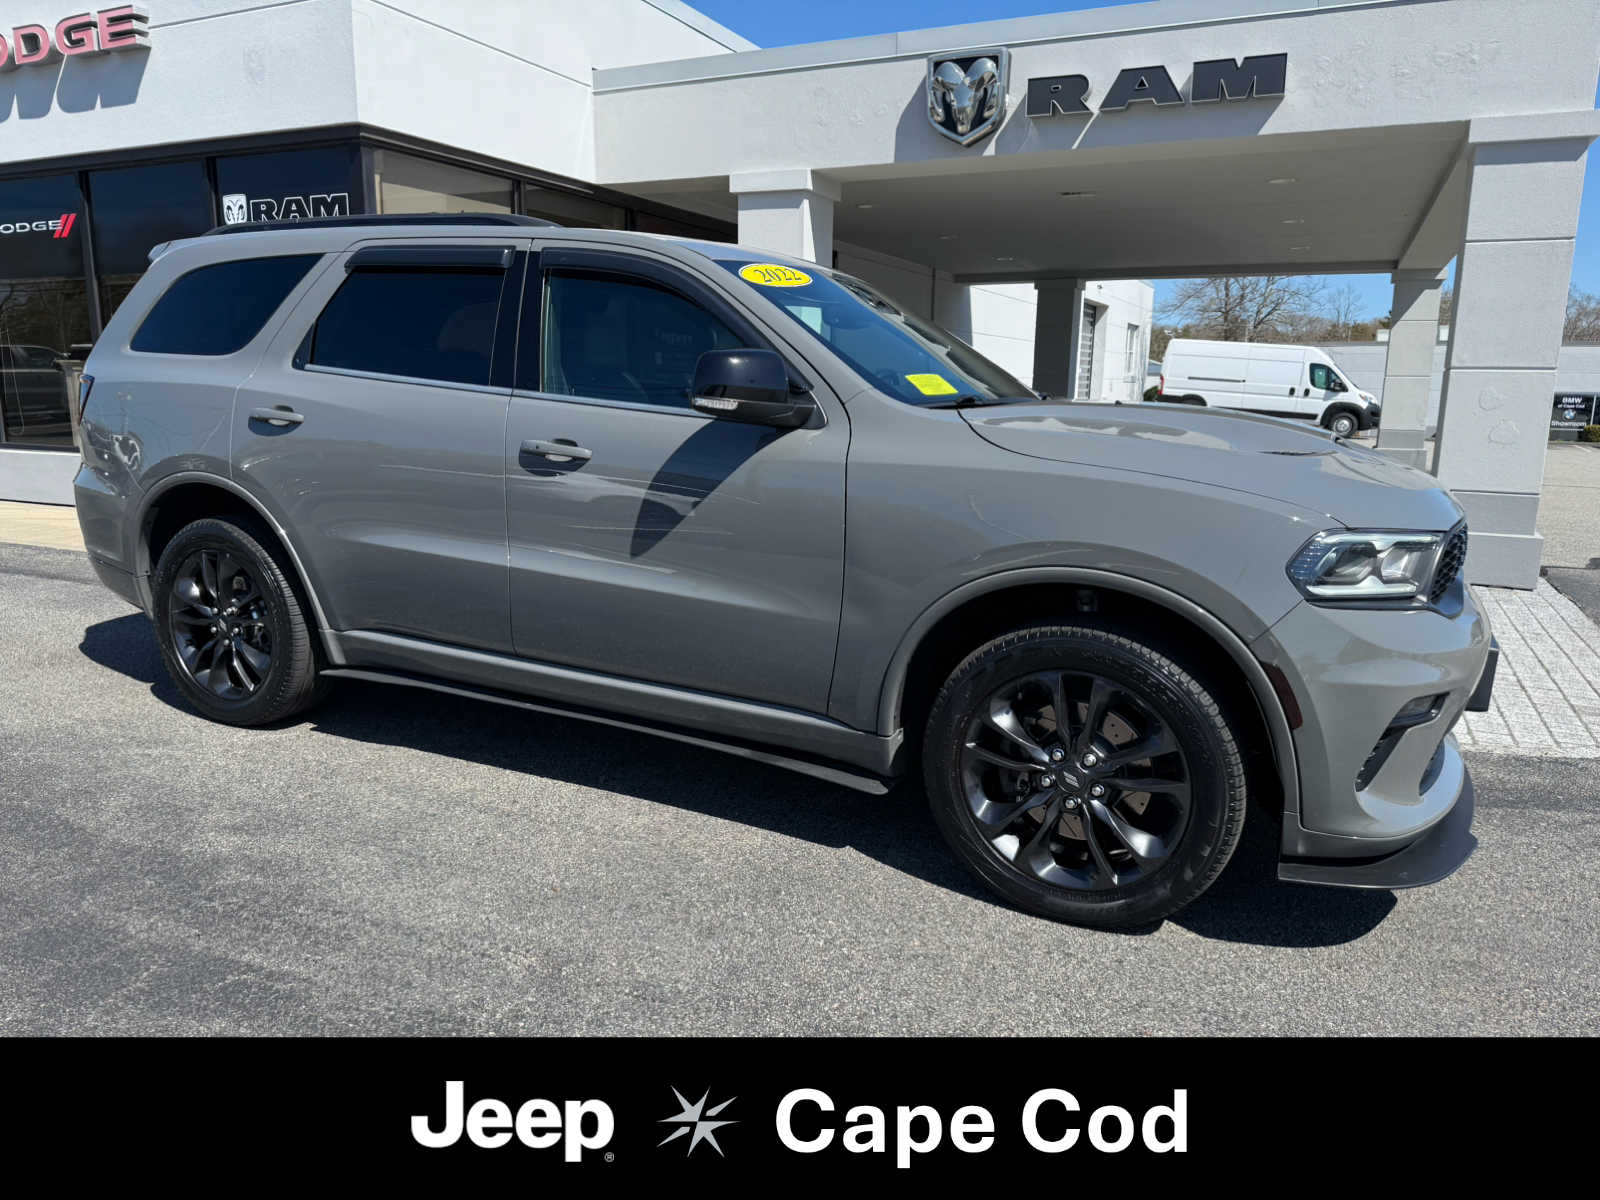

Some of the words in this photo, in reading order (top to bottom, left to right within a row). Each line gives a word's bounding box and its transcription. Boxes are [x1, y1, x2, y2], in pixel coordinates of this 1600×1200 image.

[0, 4, 140, 68] DGE
[1025, 52, 1288, 118] RAM
[249, 193, 350, 223] RAM
[753, 267, 803, 283] 2022
